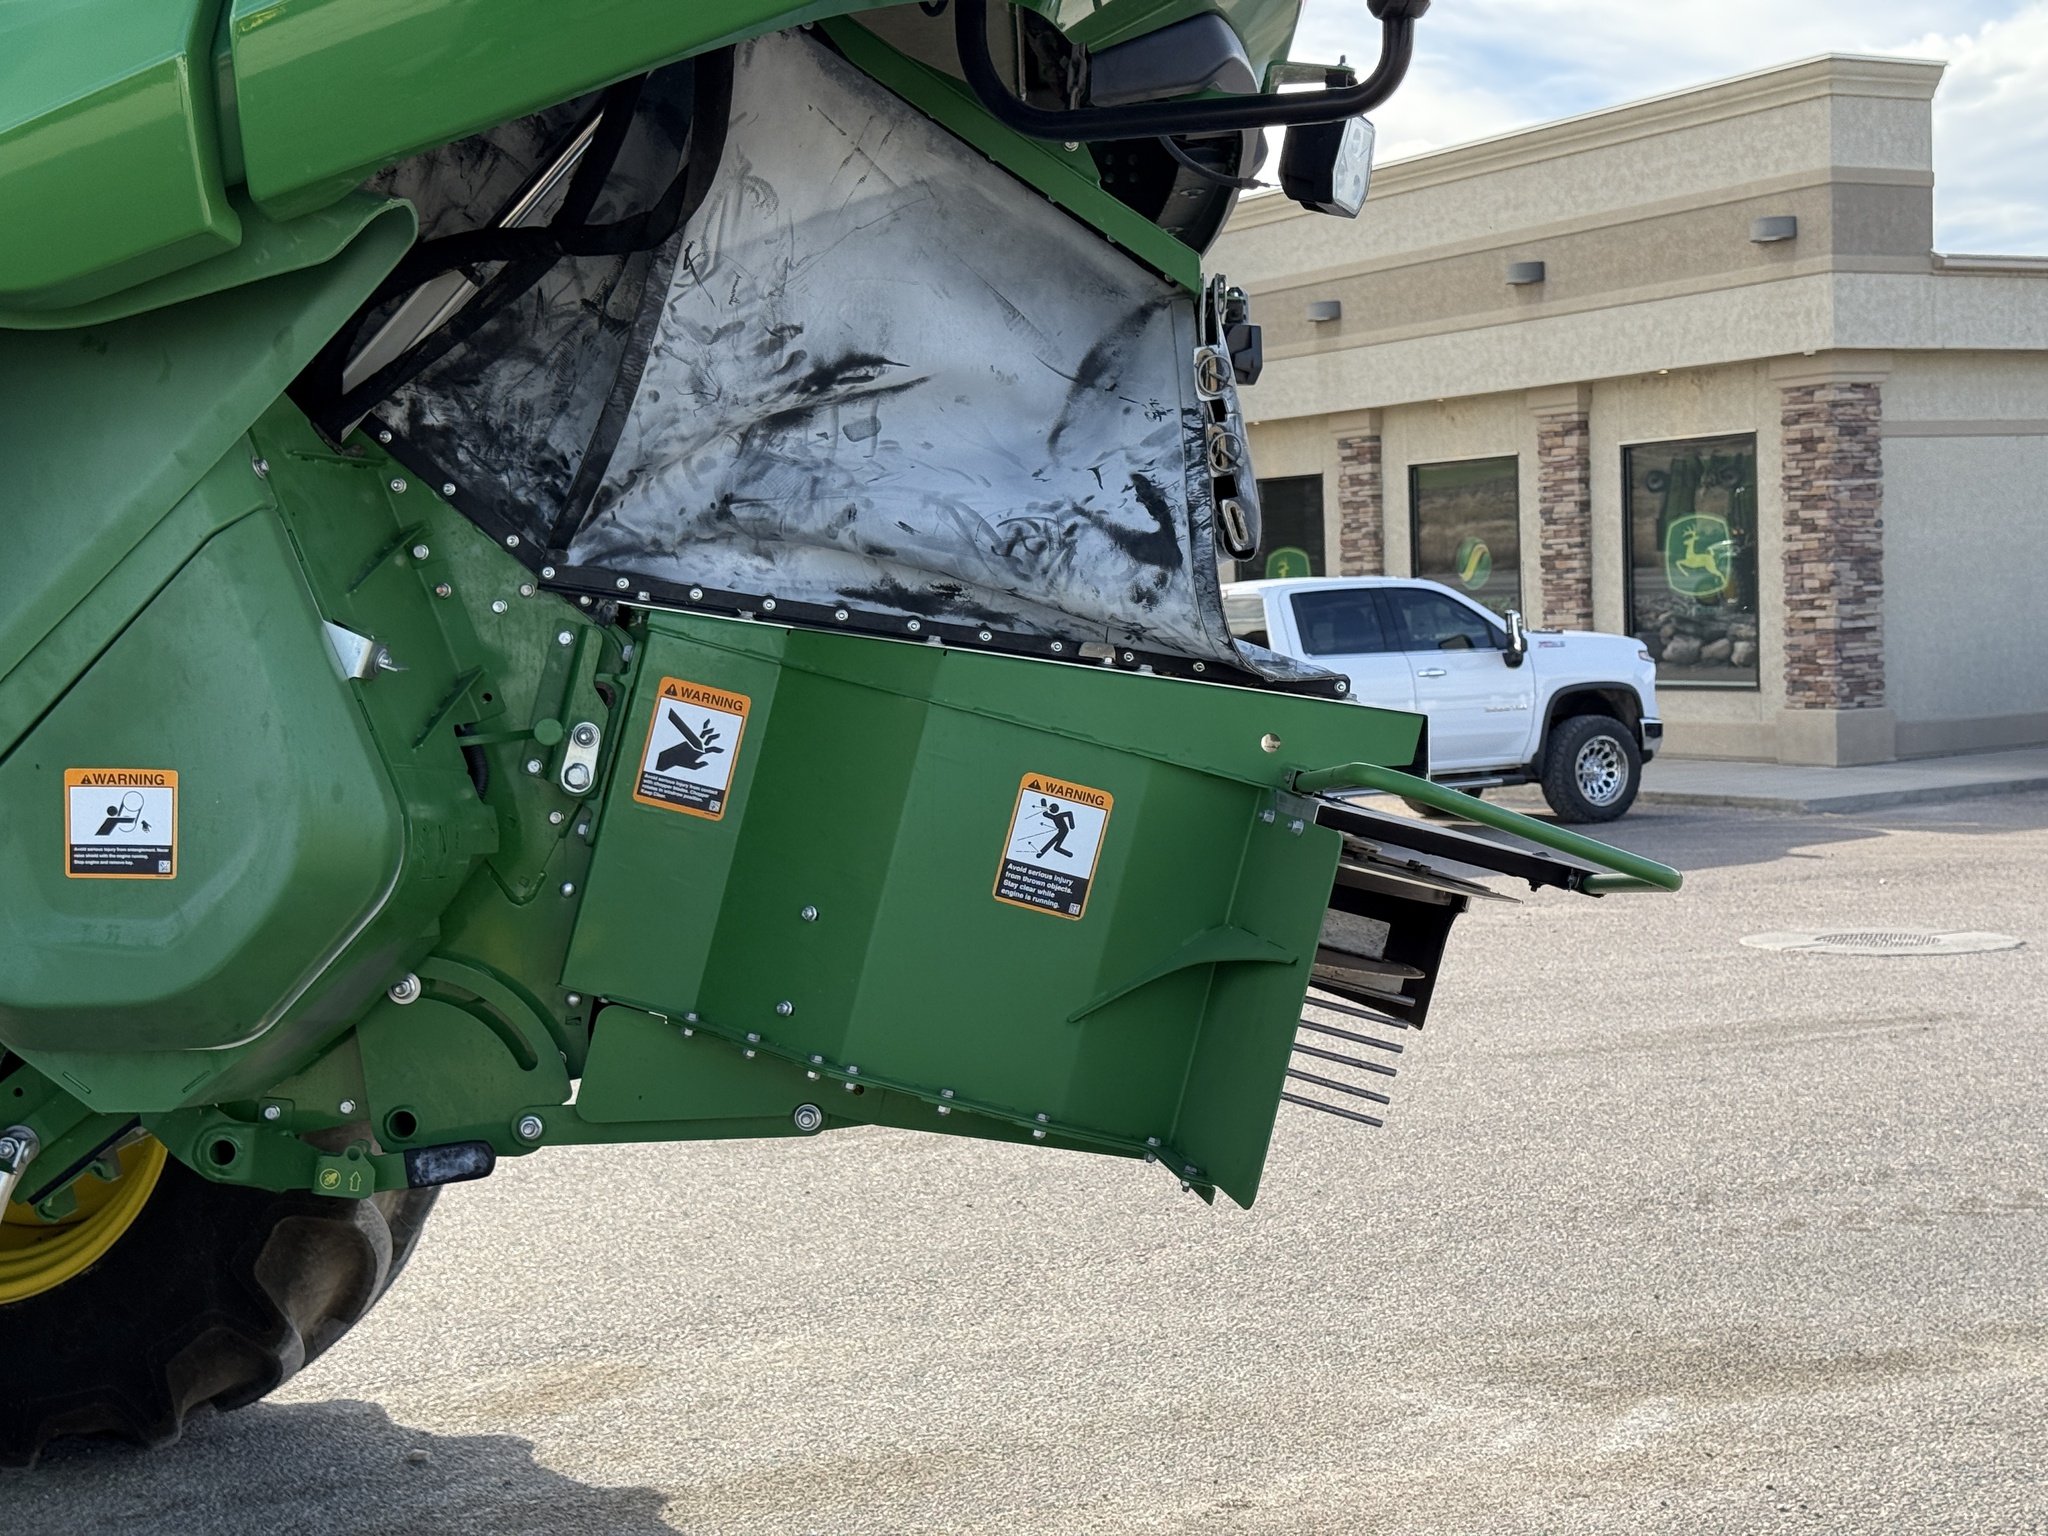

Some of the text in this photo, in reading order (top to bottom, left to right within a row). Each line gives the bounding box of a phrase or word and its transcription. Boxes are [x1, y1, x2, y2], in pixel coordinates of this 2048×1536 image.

[681, 686, 743, 711] WARNING
[92, 773, 165, 785] WARNING
[1045, 781, 1105, 806] WARNING
[1005, 871, 1073, 894] from thrown objects.
[1007, 863, 1074, 886] Avoid serious injury
[1000, 888, 1024, 899] engine
[1032, 896, 1060, 908] running.
[1003, 879, 1055, 898] Stay clear while
